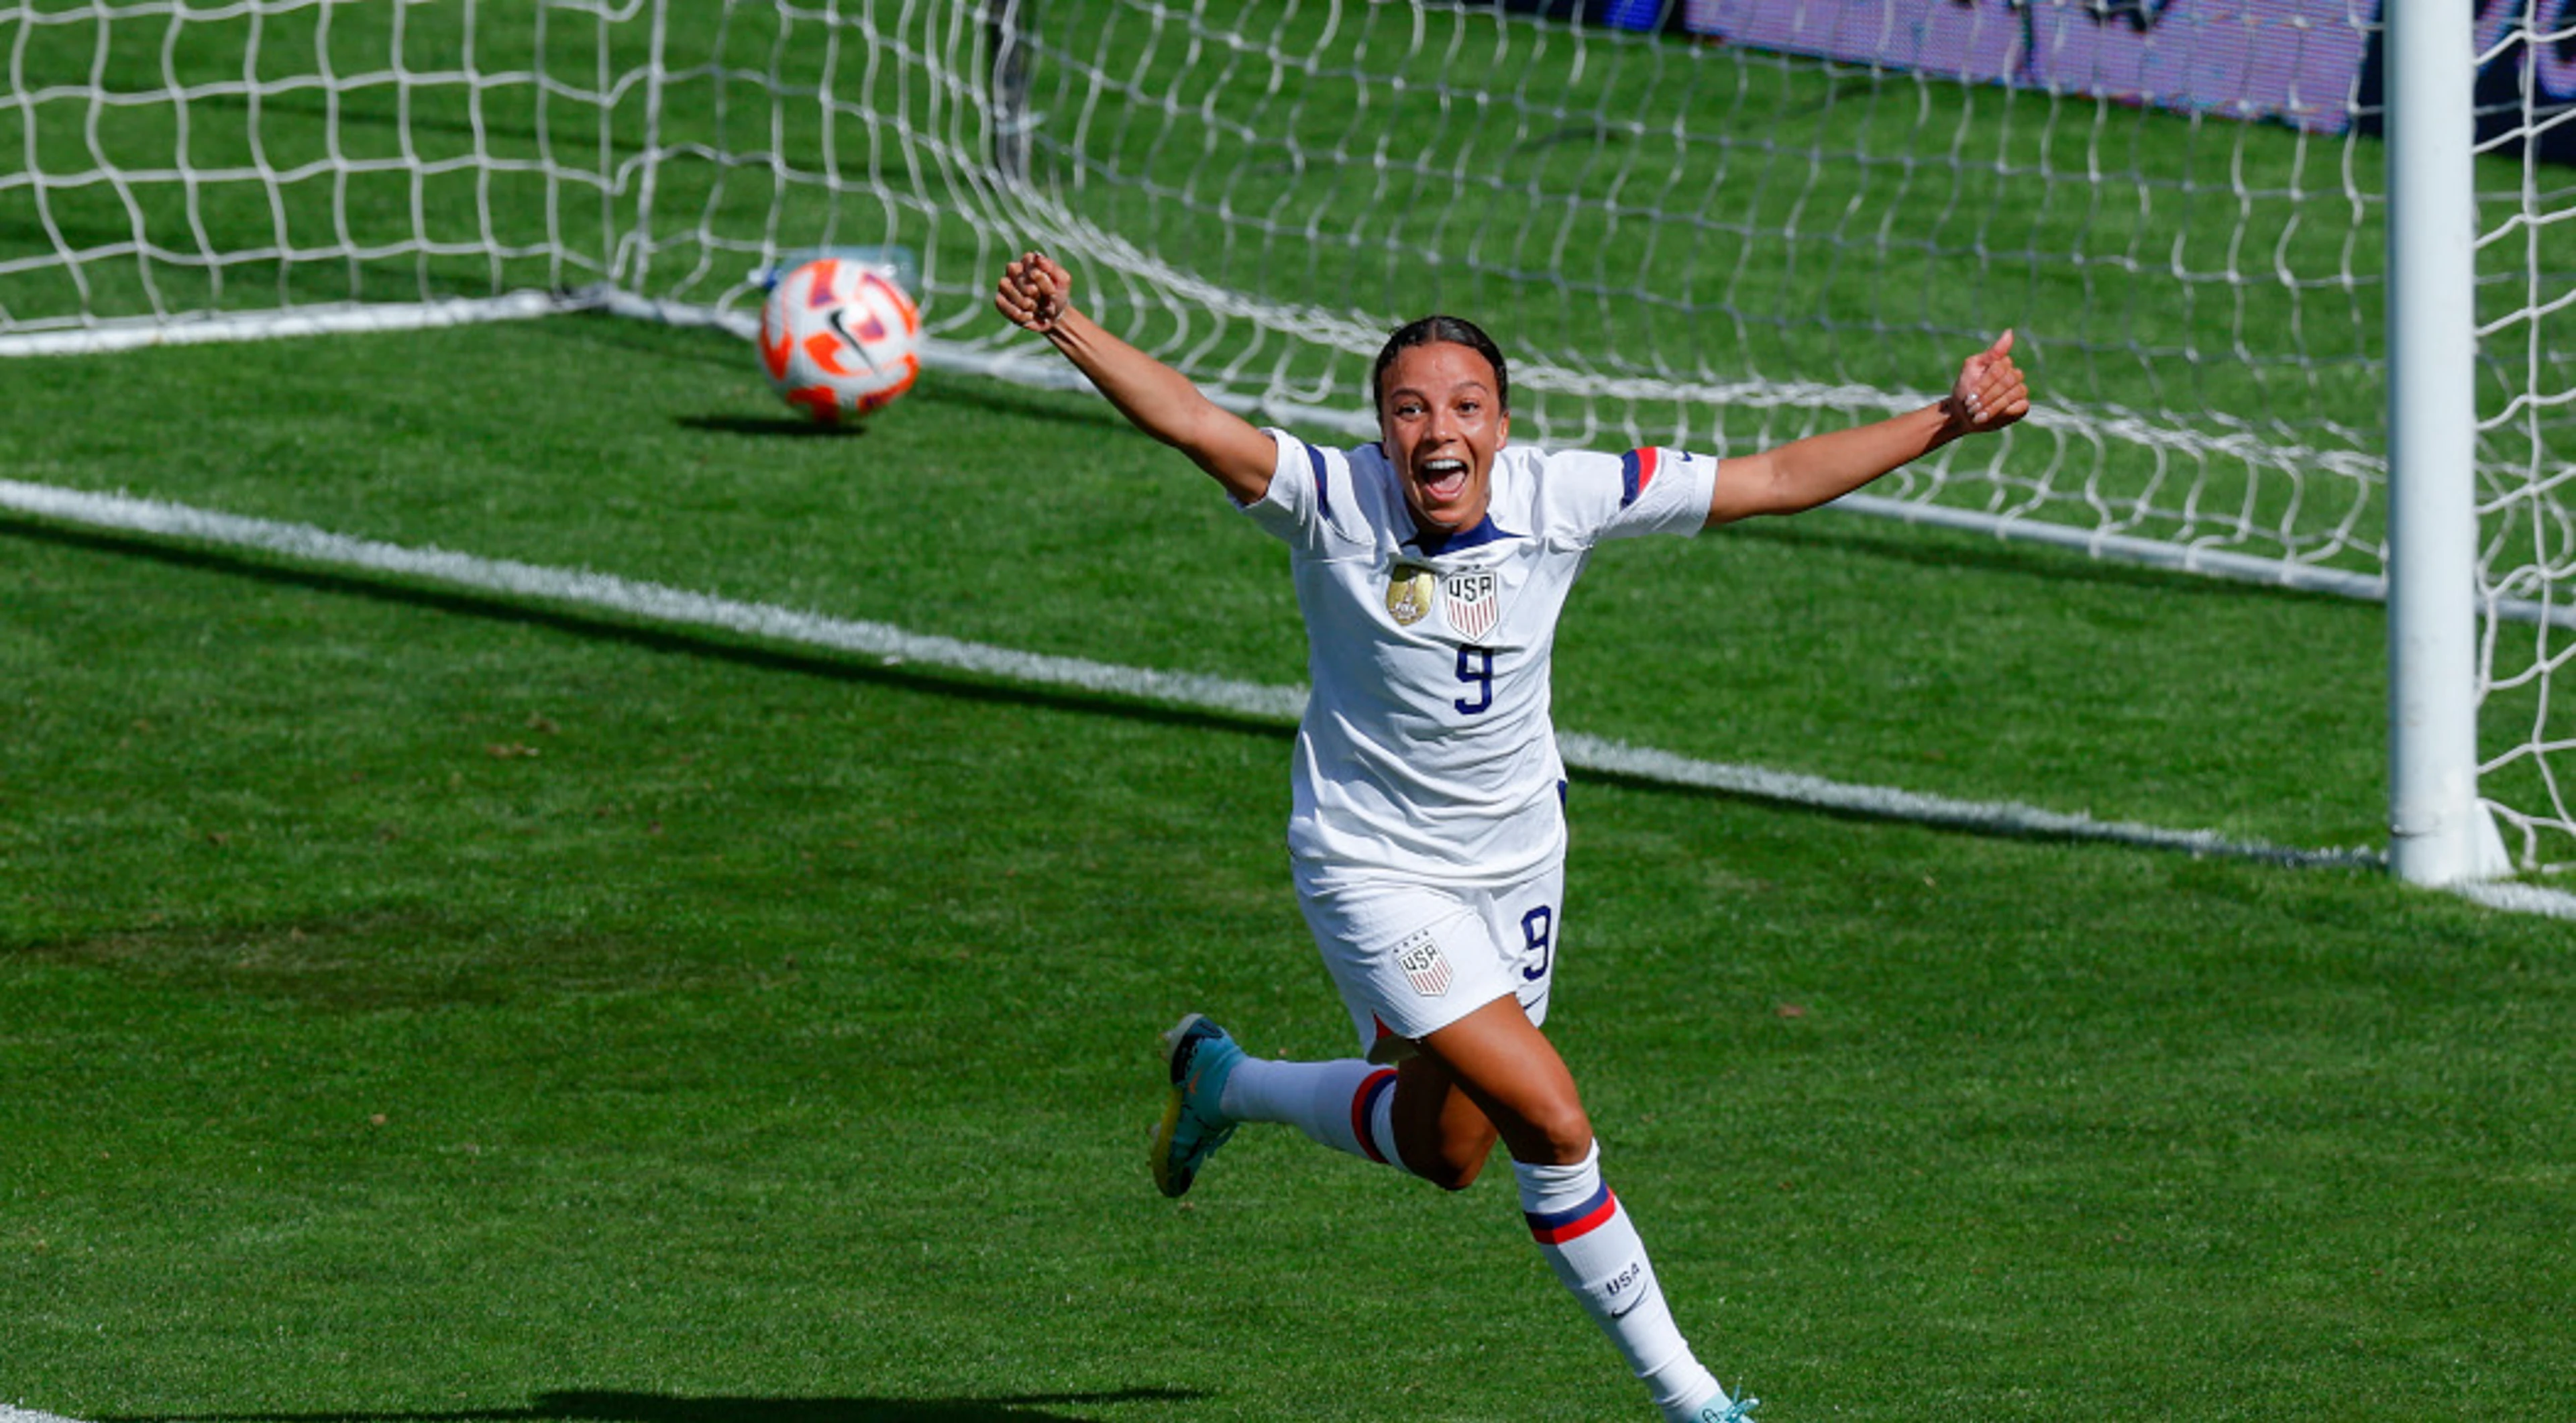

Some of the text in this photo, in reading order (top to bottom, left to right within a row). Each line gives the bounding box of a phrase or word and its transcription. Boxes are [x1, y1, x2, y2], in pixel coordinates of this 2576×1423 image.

[1449, 576, 1492, 602] USA
[1454, 643, 1493, 715] 9
[1403, 945, 1436, 970] USA
[1521, 905, 1551, 982] 9
[1606, 1263, 1640, 1296] USA
